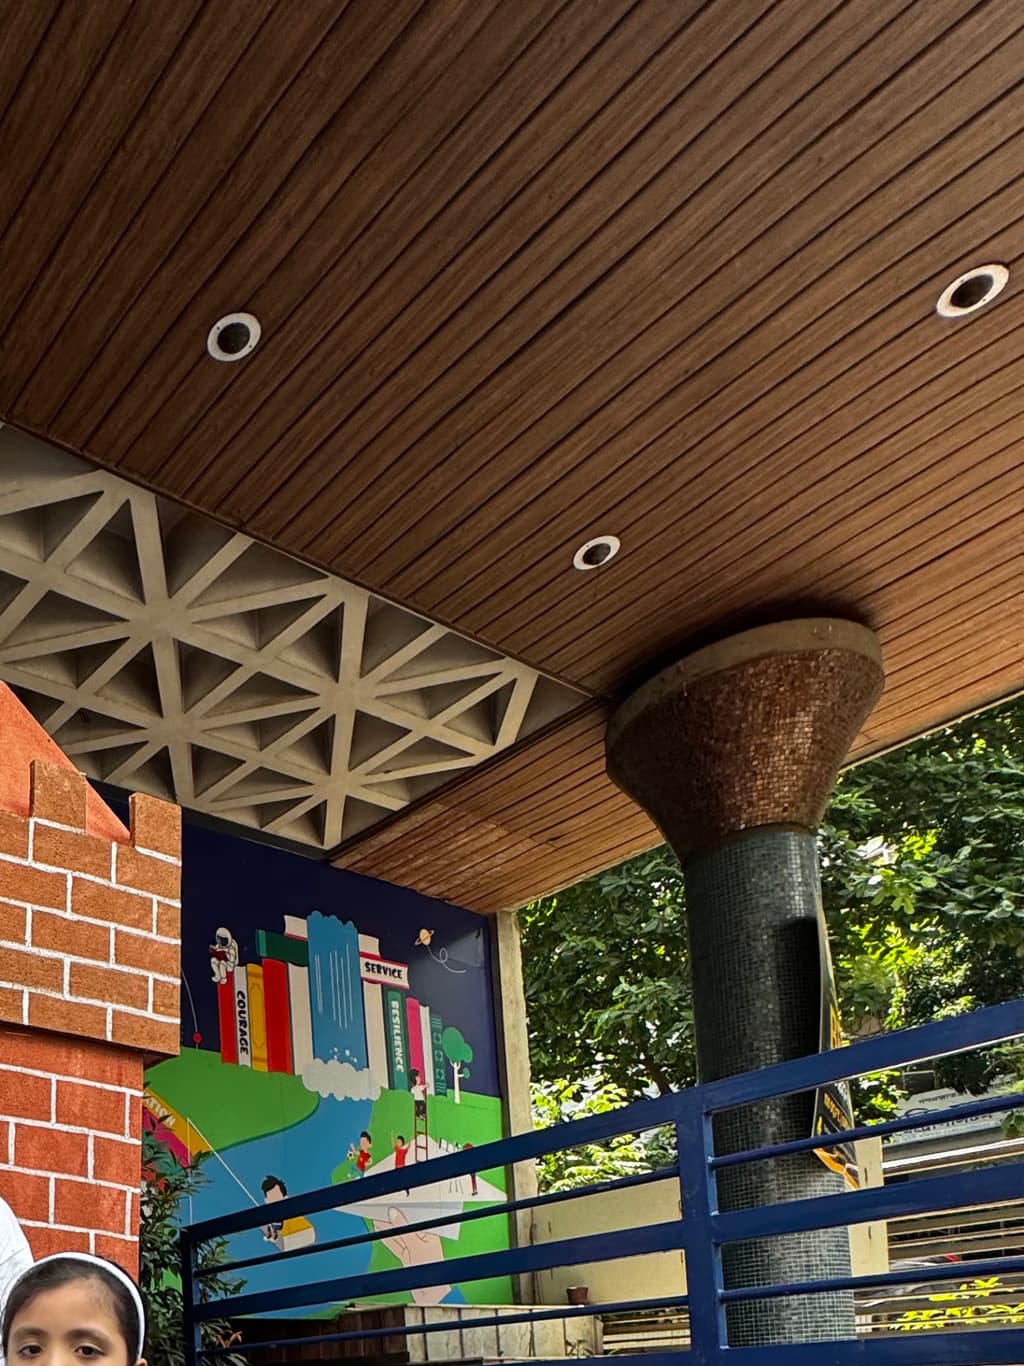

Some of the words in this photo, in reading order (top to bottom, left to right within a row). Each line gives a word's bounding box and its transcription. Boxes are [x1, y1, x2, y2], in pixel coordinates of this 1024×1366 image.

[364, 961, 403, 979] SERVICE
[236, 990, 249, 1055] COURAGE
[391, 1000, 405, 1073] RESILIENCE
